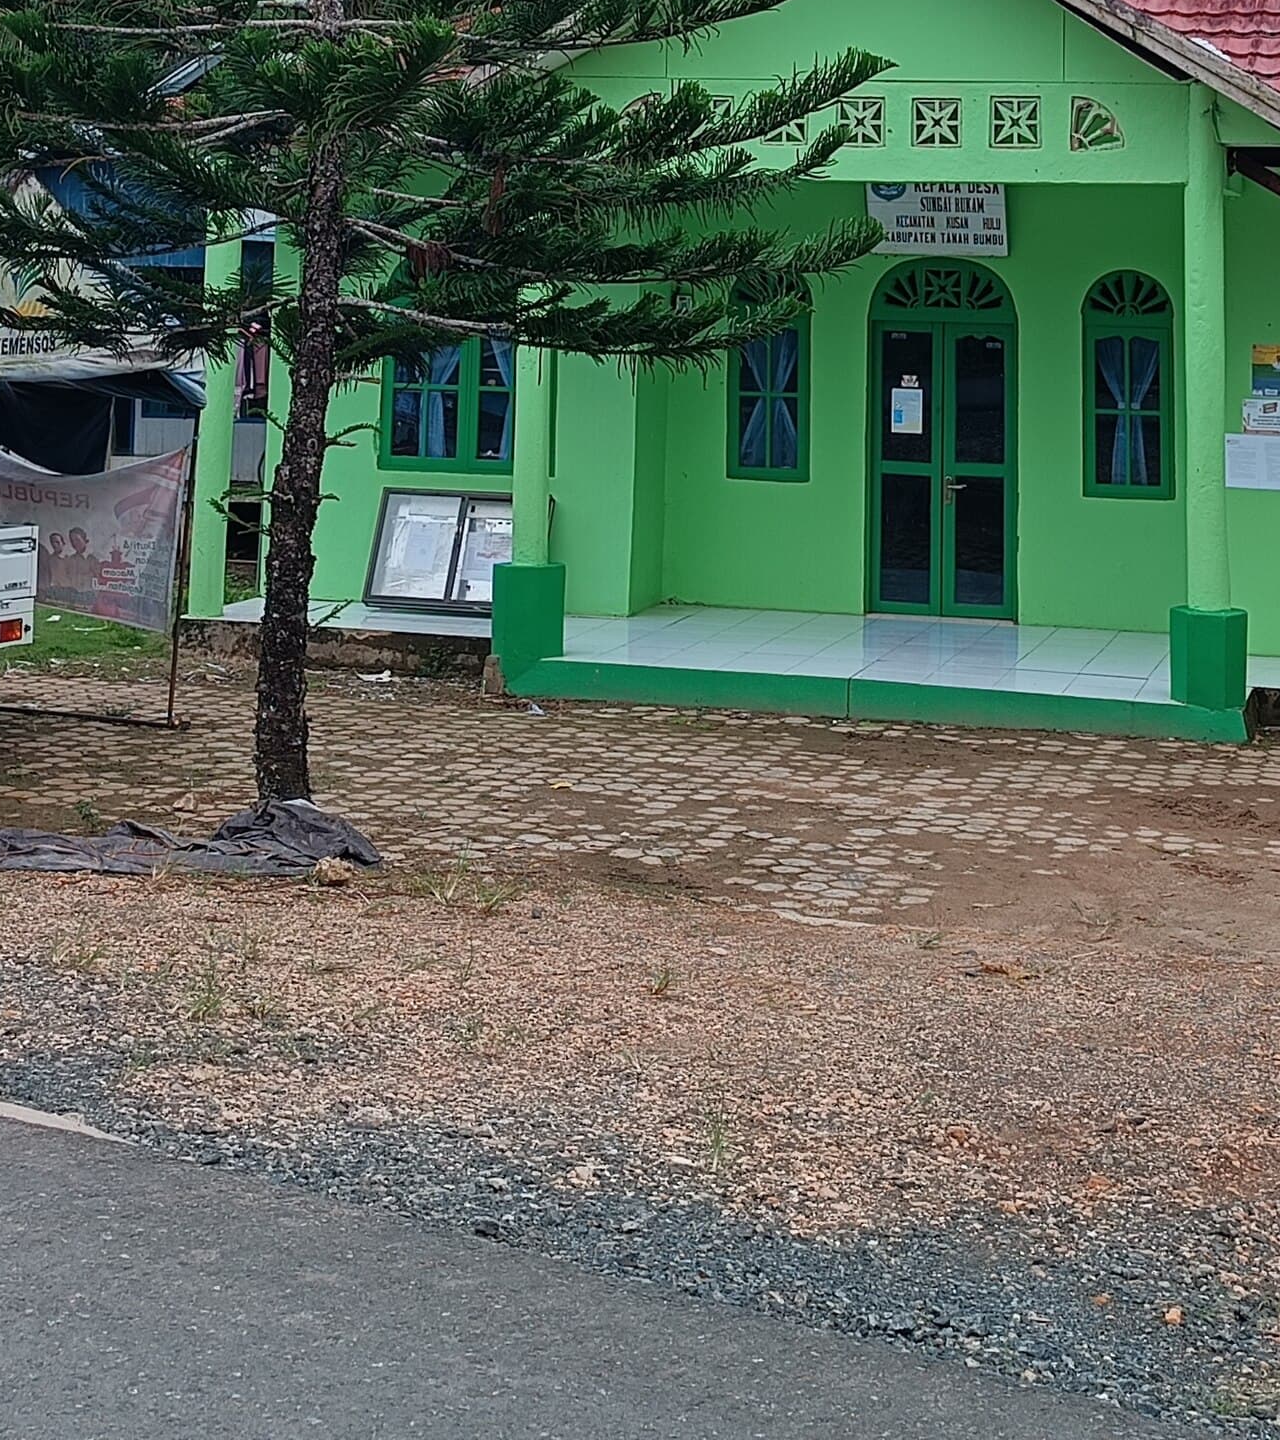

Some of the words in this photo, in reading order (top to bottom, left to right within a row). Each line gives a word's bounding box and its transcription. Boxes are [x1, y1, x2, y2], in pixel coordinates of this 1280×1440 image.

[920, 197, 951, 213] SUNGAI
[955, 198, 985, 214] RUKAM
[896, 215, 935, 229] KECAMATAN
[946, 217, 969, 229] KUSAN
[983, 217, 1001, 230] HULU
[884, 231, 936, 244] KABUPATEN
[941, 233, 969, 245] TANAH
[973, 233, 1004, 245] BUMBU
